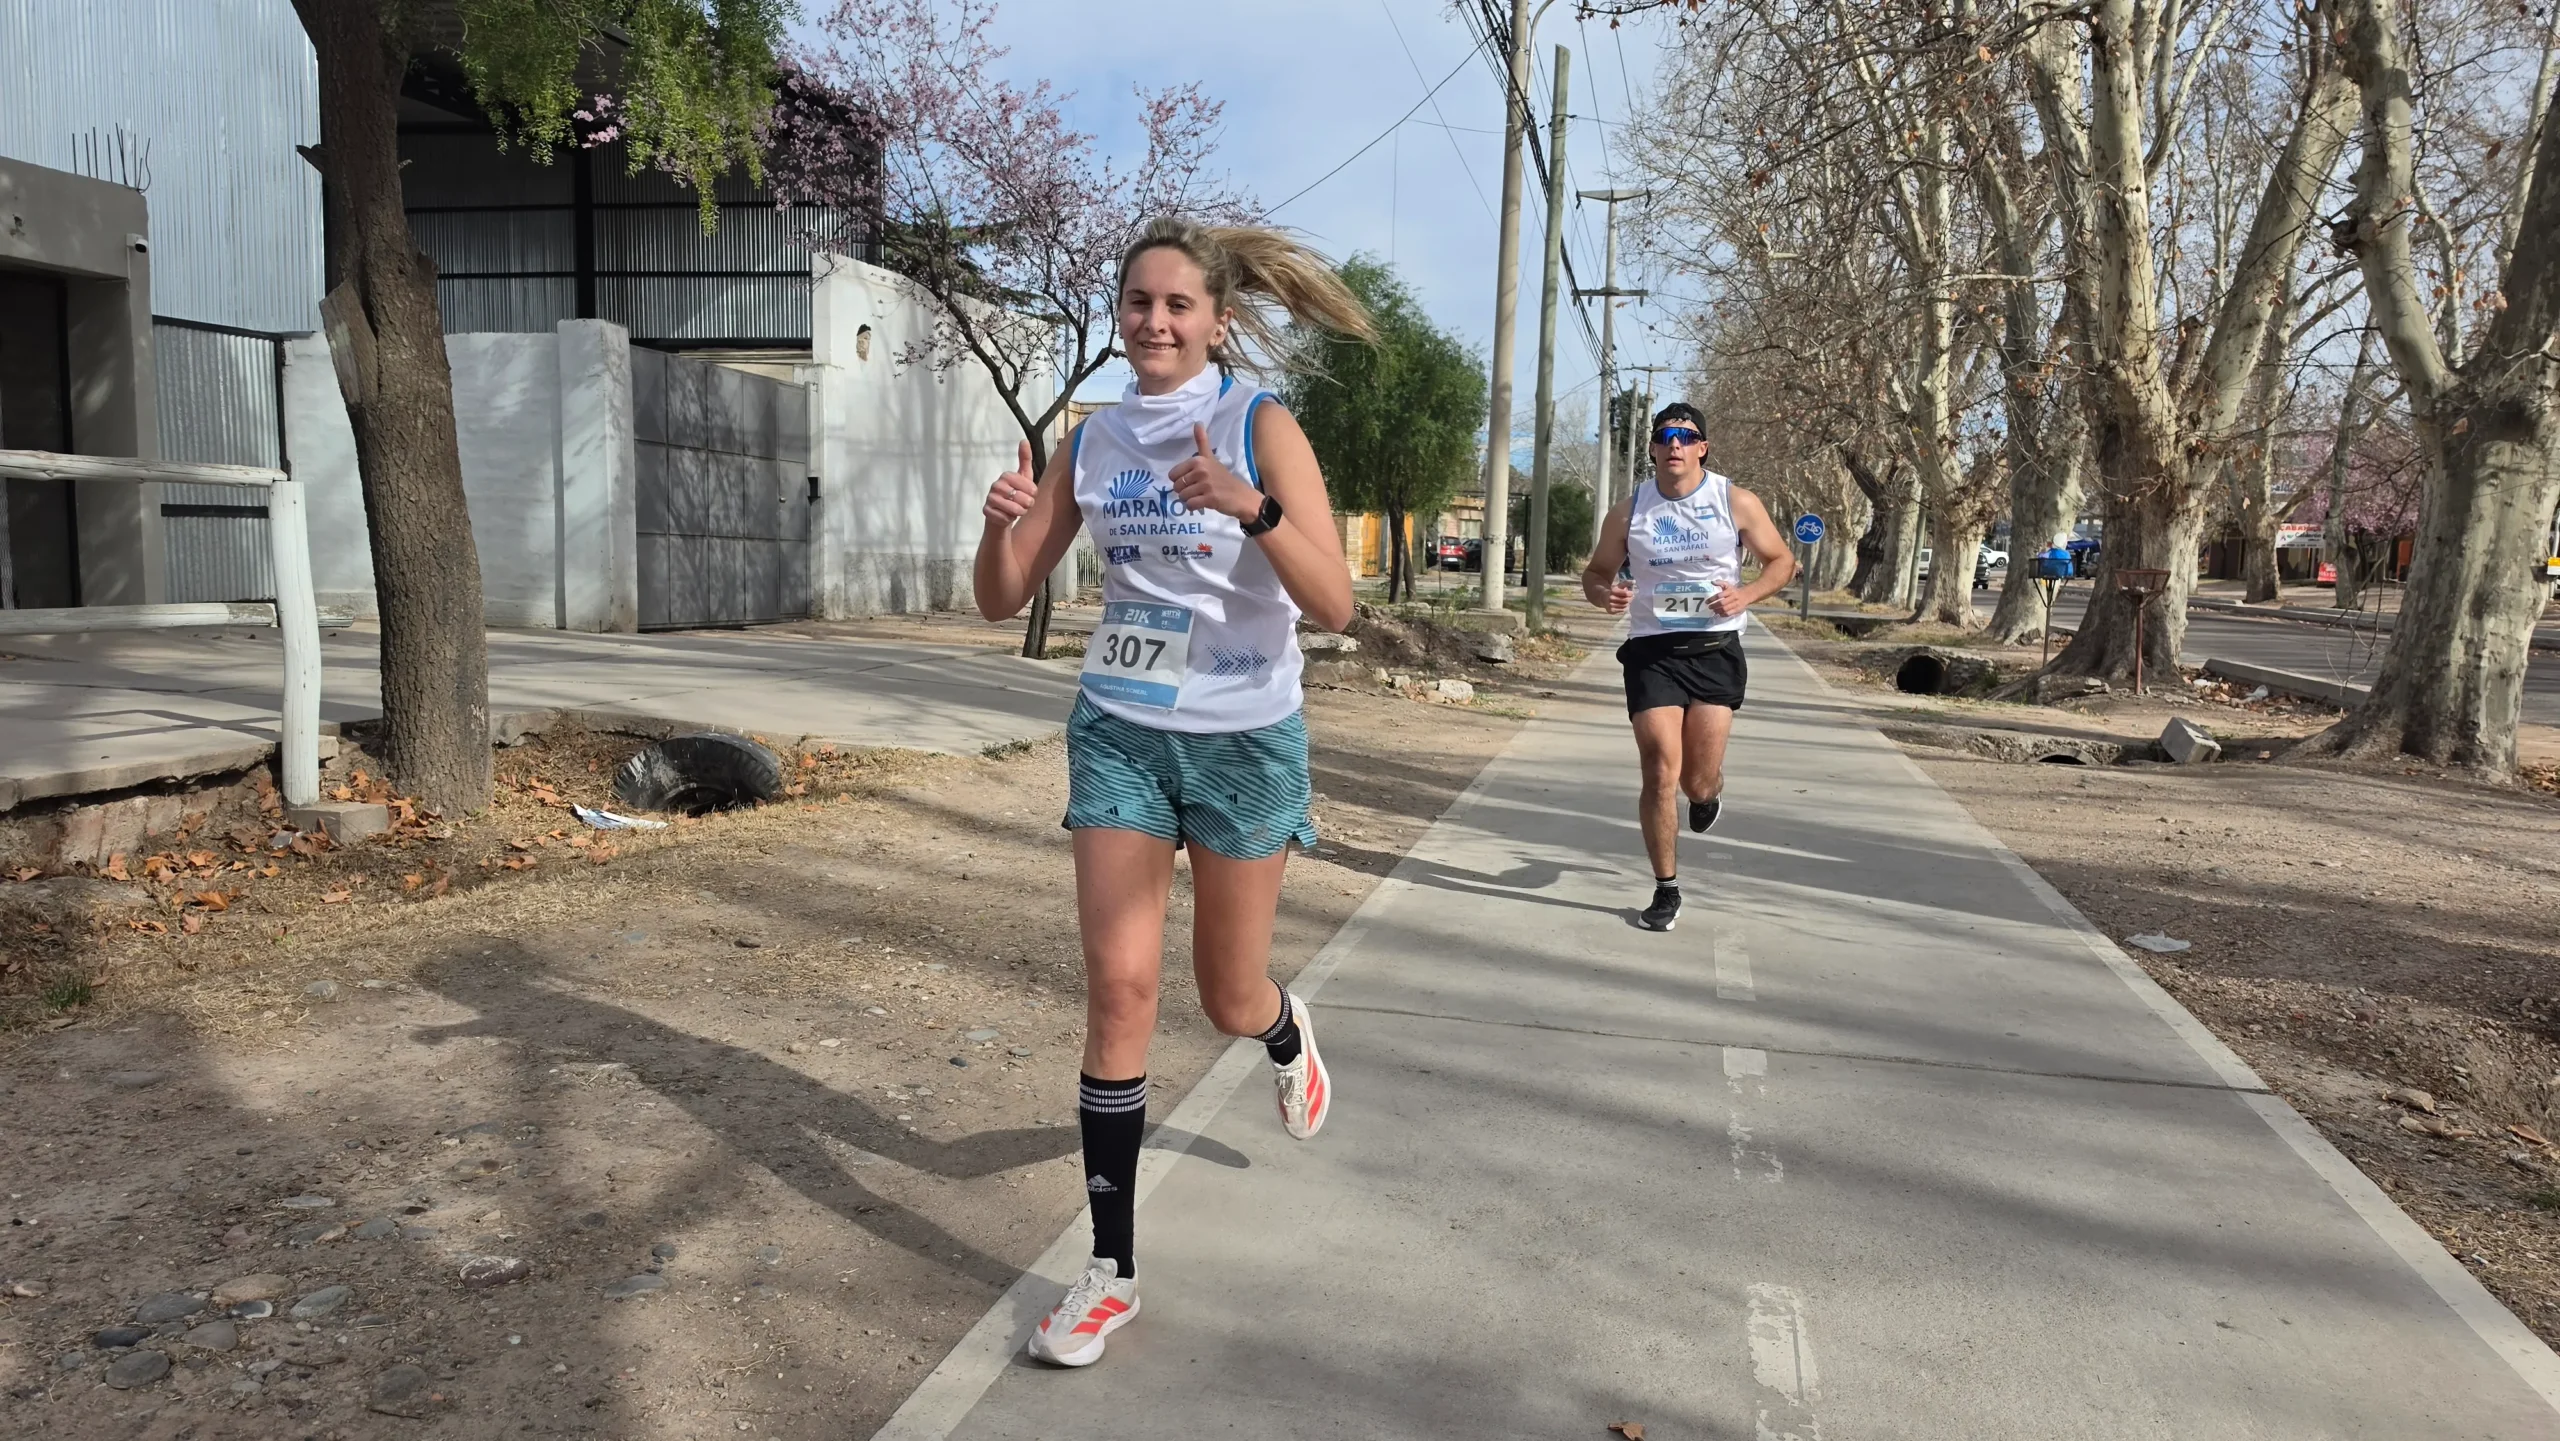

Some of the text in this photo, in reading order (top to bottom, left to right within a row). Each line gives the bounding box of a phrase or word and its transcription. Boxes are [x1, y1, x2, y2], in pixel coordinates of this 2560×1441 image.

[1109, 523, 1205, 536] DE SAN RAFAEL
[1681, 543, 1709, 551] RAFAEL
[1665, 597, 1705, 613] 217
[1124, 604, 1152, 624] 21K
[1103, 633, 1167, 671] 307
[1100, 683, 1125, 692] AGUSTINA
